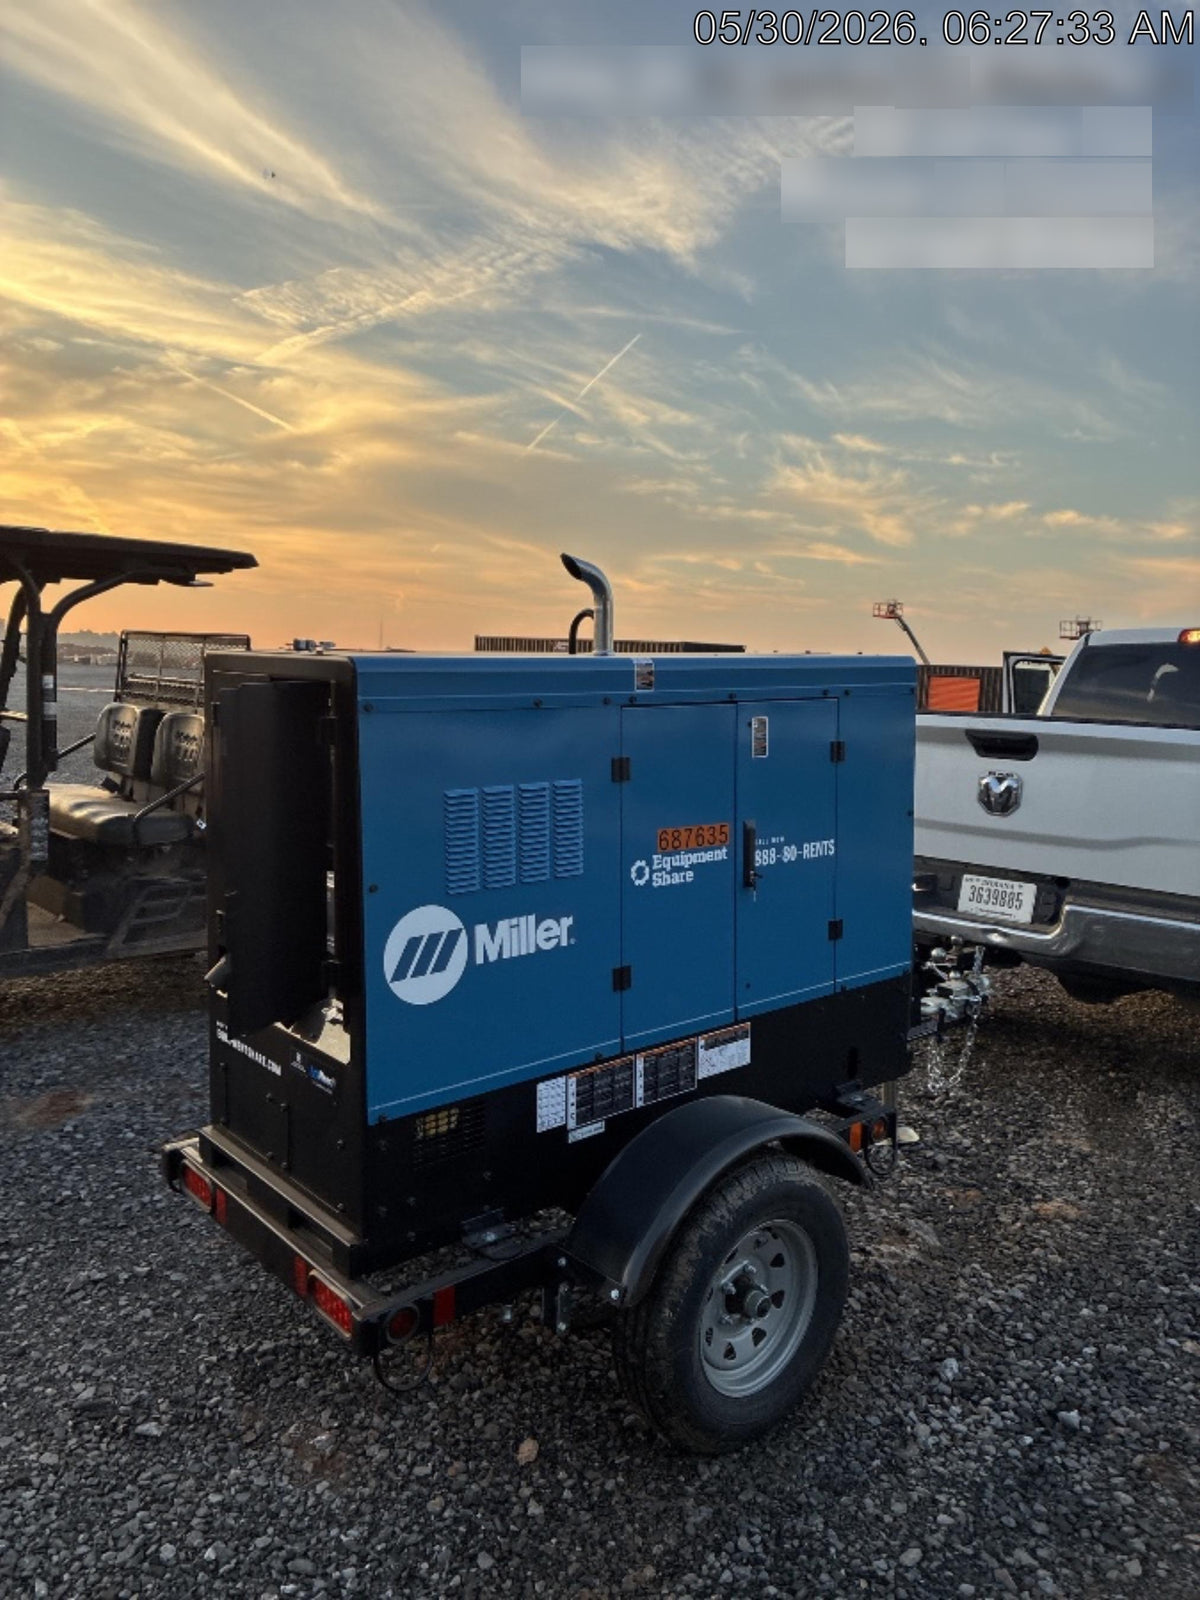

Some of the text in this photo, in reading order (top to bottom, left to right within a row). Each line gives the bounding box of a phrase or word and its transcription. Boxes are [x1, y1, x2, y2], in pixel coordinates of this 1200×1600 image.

[658, 824, 729, 851] 687635
[652, 846, 728, 871] Equipment
[652, 870, 694, 887] Share
[474, 912, 574, 965] Miller
